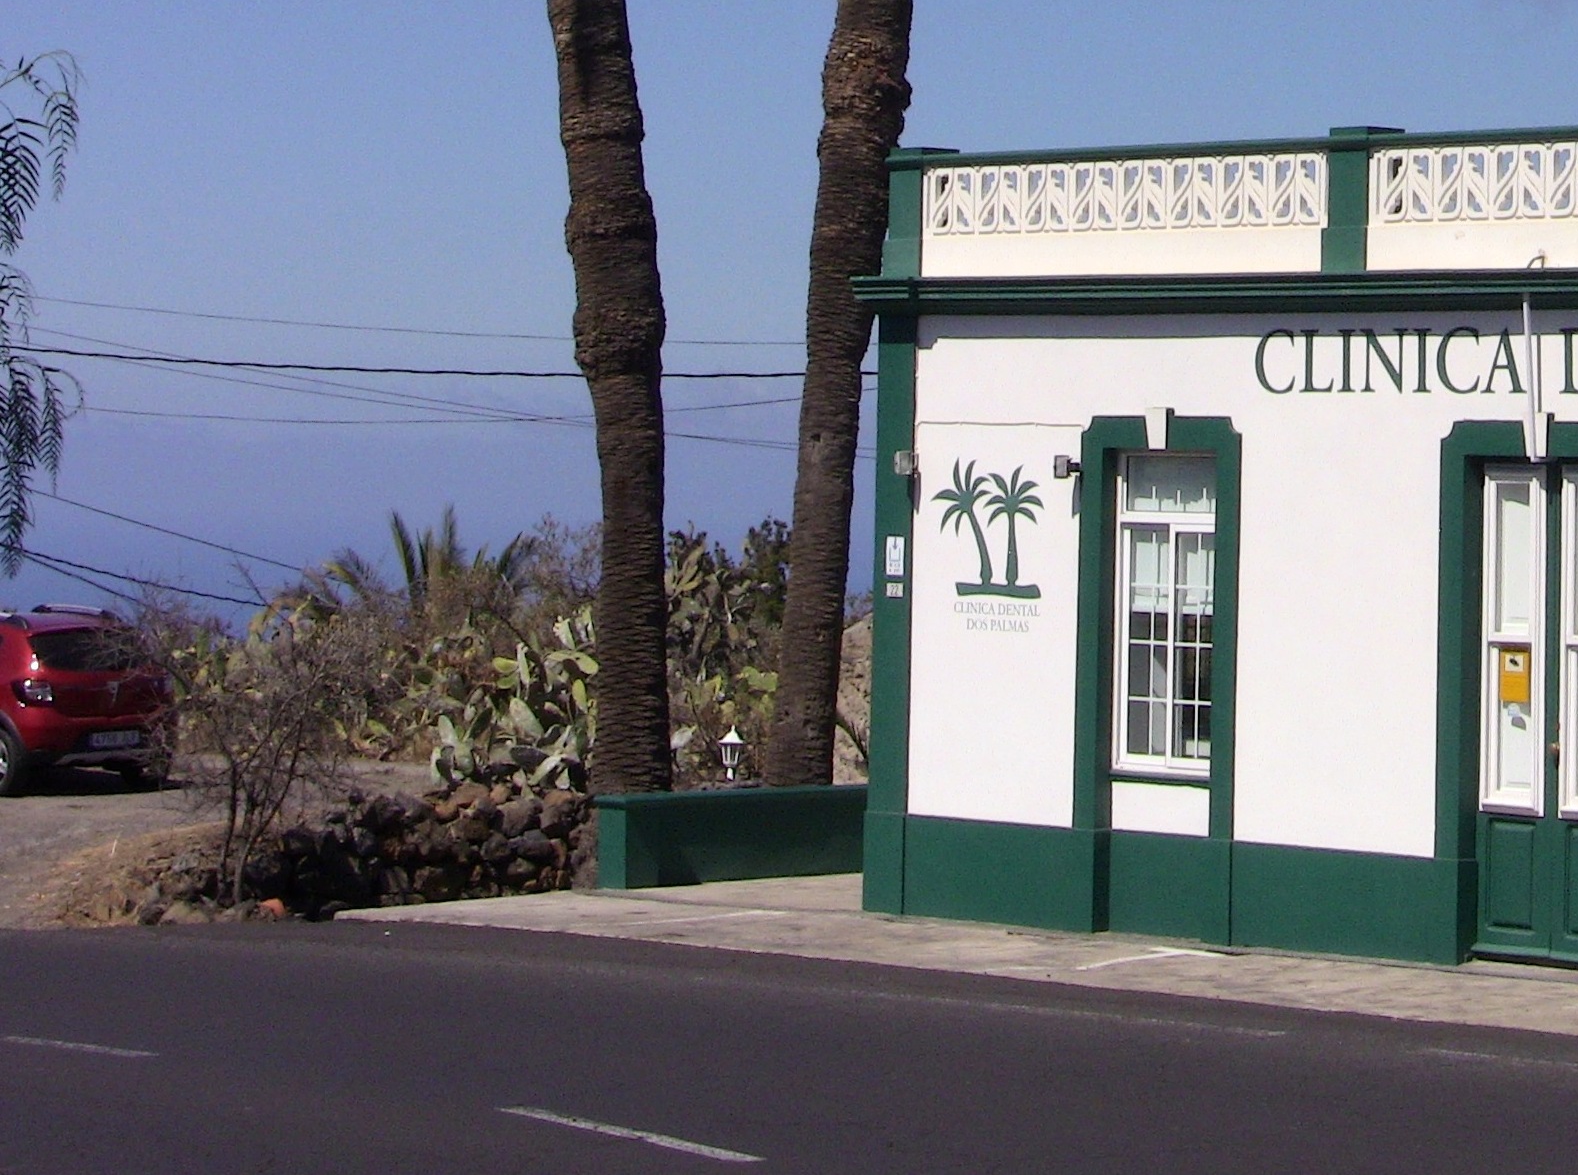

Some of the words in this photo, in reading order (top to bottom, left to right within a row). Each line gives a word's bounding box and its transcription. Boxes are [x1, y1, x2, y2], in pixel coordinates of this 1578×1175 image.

[1254, 325, 1527, 395] CLINICA
[954, 601, 995, 616] CLINICA
[998, 603, 1040, 617] DENTAL
[966, 618, 988, 631] DOS
[990, 619, 1030, 633] PALMAS
